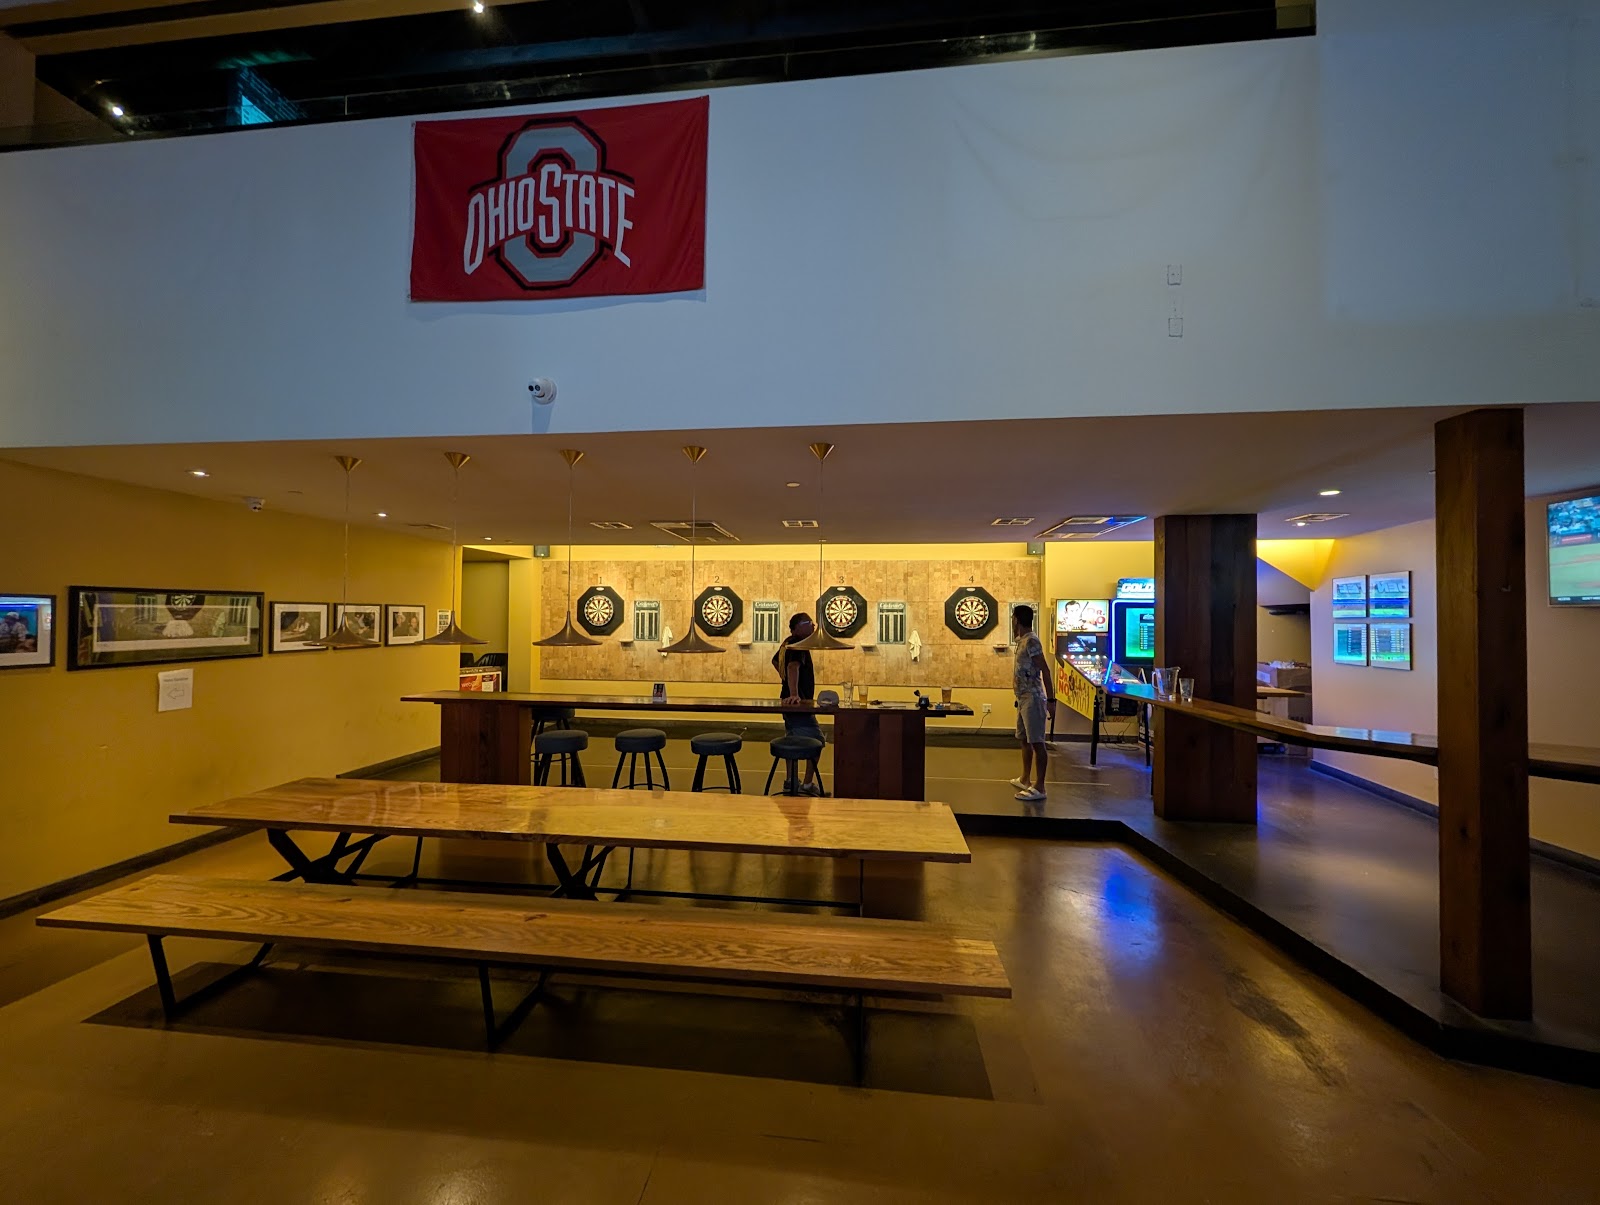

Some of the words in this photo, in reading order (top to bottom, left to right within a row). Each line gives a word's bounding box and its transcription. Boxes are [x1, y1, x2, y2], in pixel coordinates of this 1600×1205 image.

[463, 176, 536, 275] OHIO
[538, 163, 636, 268] STATE
[714, 575, 720, 584] 2
[838, 575, 845, 584] 3
[968, 575, 975, 584] 4
